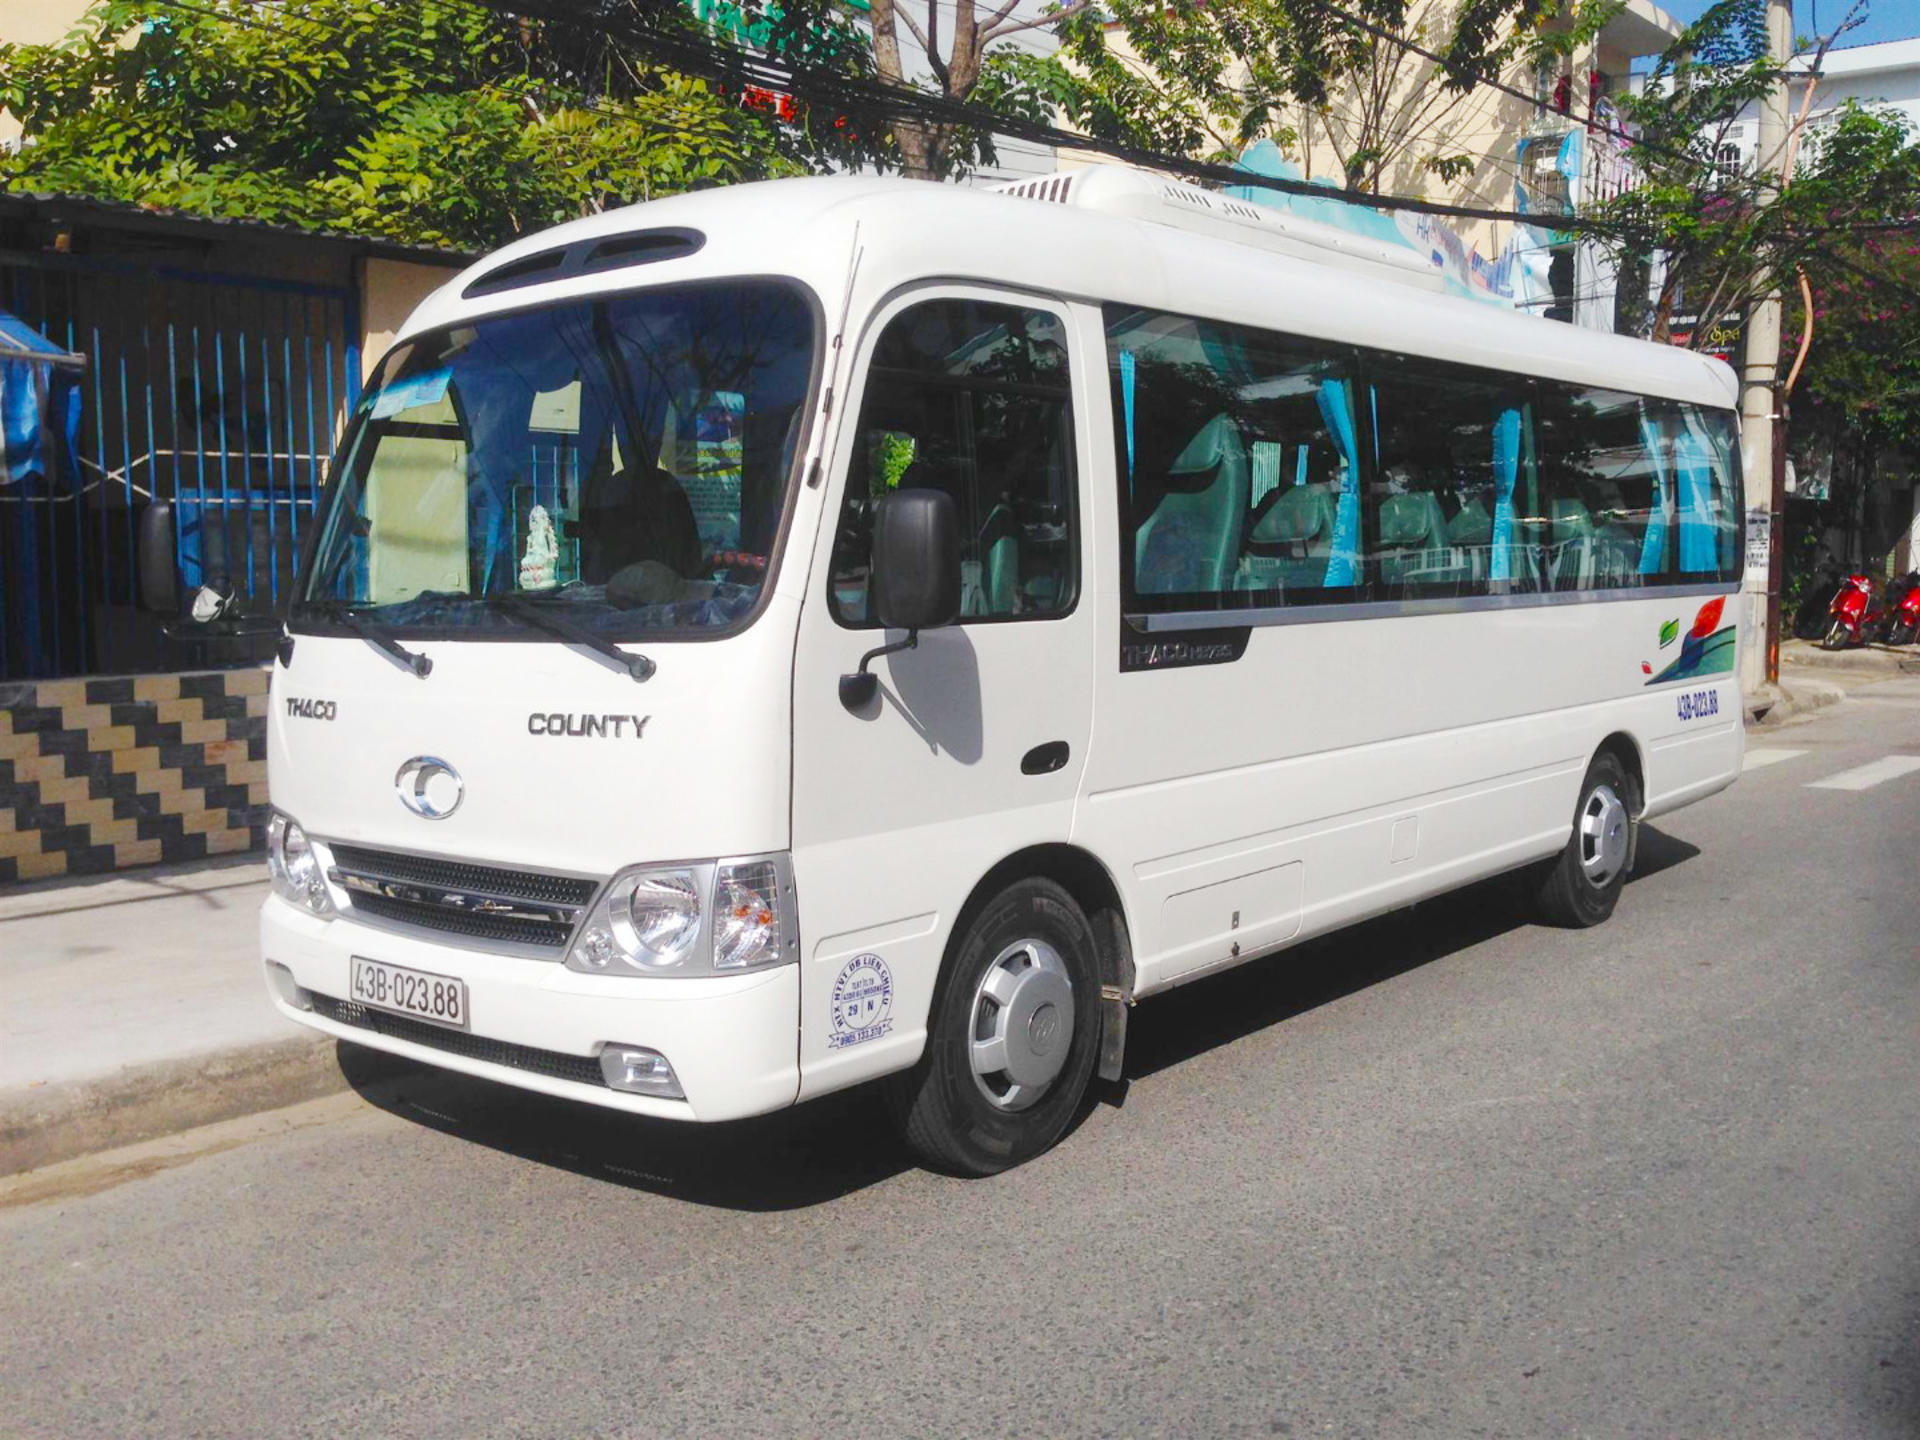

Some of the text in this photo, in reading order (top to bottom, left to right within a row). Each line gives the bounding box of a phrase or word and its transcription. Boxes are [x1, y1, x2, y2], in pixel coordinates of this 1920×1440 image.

[286, 698, 337, 721] THACO
[527, 712, 651, 739] COUNTY
[867, 1000, 874, 1011] N
